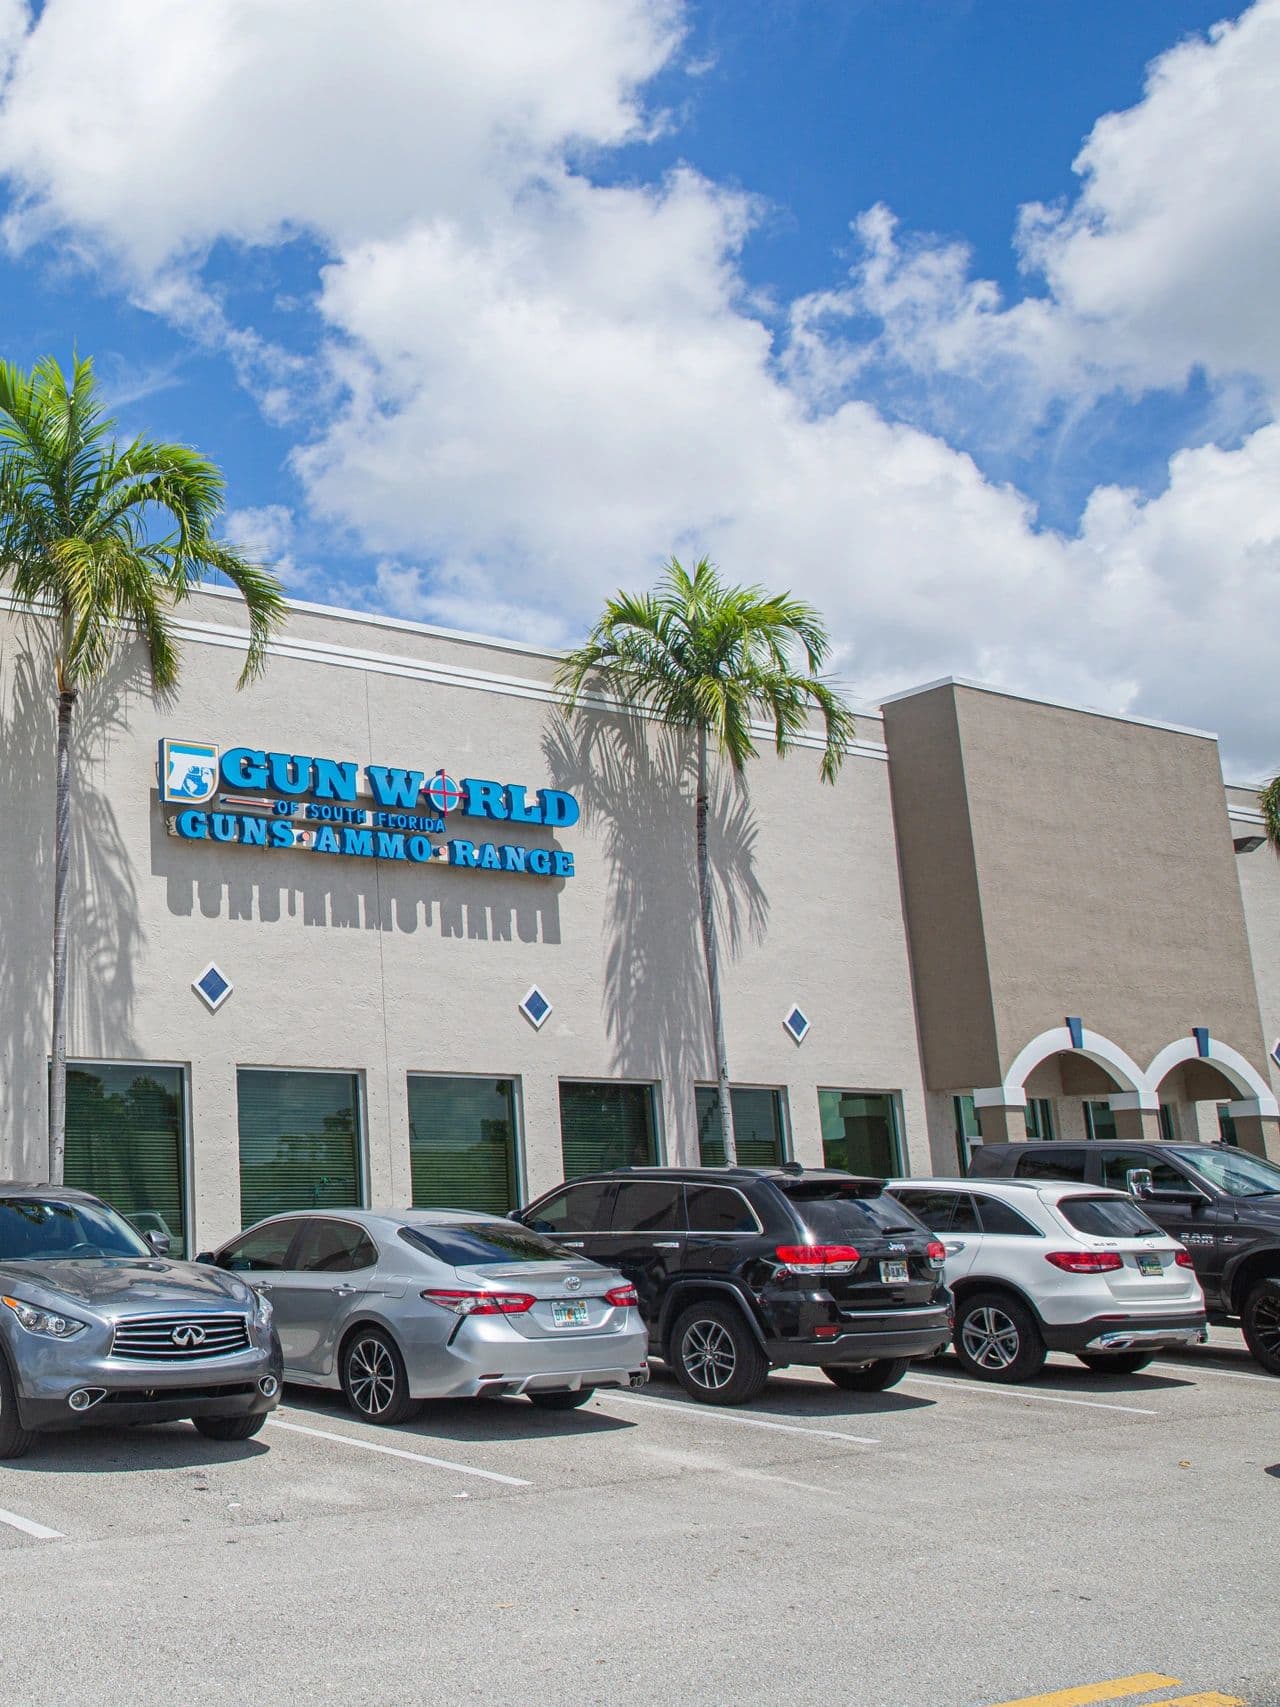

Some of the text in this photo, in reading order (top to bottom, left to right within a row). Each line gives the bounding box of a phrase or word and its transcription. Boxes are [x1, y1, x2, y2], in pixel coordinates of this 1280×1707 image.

[220, 746, 580, 828] GUN WORLD
[274, 799, 447, 833] OF SOUTH FLORIDA
[176, 809, 576, 877] GUNS AMMO RANGE
